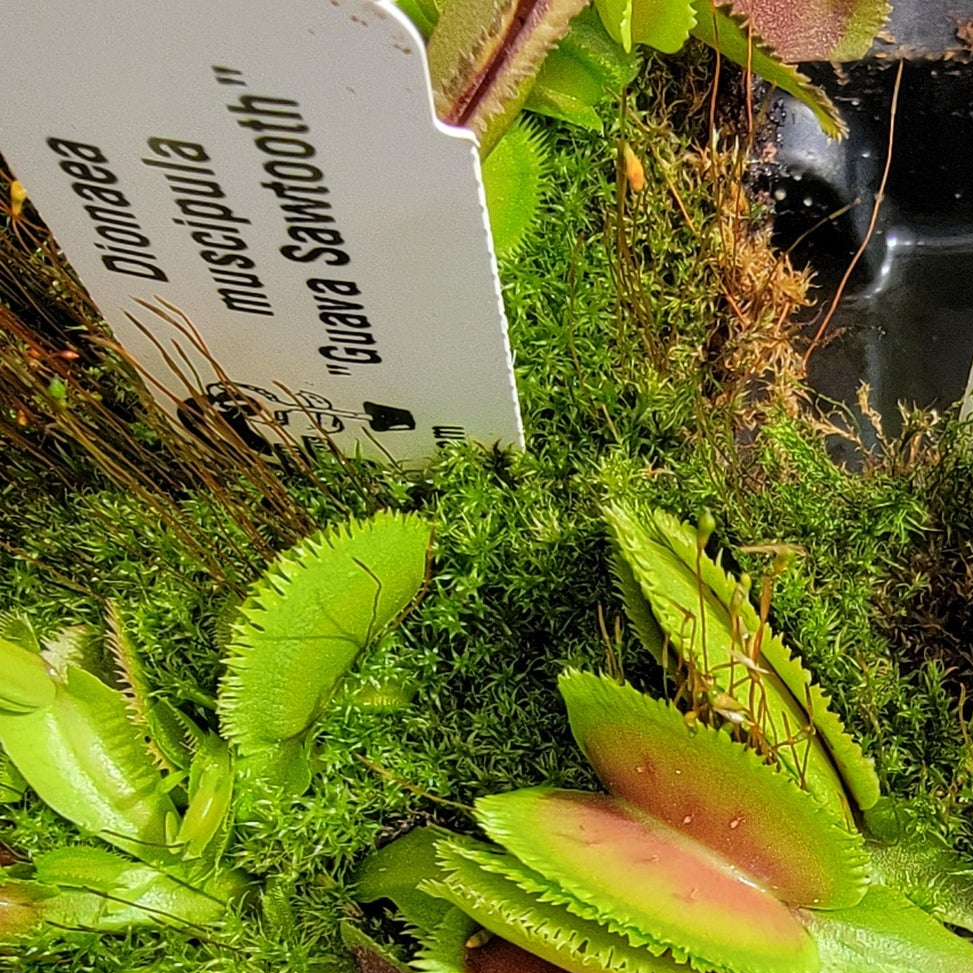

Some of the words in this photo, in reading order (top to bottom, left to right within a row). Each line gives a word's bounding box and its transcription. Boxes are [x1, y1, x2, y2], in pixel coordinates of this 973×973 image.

[46, 137, 169, 282] Dionaea
[141, 136, 275, 316] muscipula
[211, 65, 350, 266] Sawtooth"
[306, 278, 382, 375] "Guava
